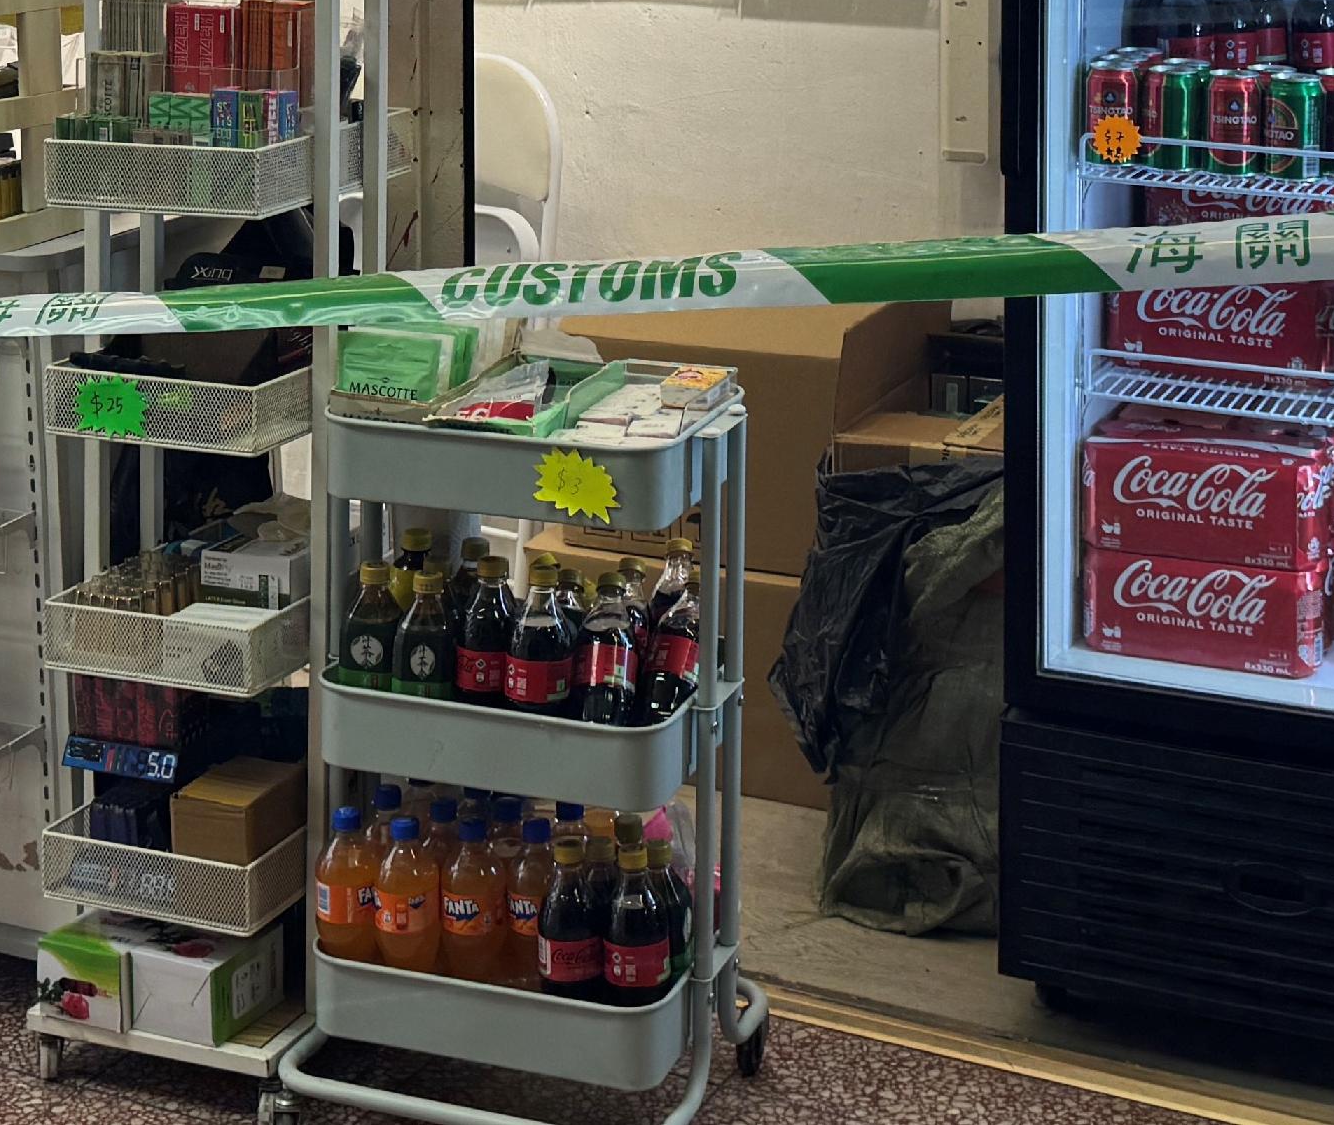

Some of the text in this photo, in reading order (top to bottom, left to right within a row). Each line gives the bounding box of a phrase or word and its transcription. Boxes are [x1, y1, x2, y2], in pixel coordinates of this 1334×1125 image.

[1089, 105, 1133, 117] TSINGTAO
[1212, 114, 1258, 125] TSINGTAO
[1126, 218, 1313, 273] 海關
[441, 251, 744, 307] CUSTOMS
[1137, 284, 1297, 339] Coca-Cola
[1158, 326, 1274, 349] ORIGINAL TASTE
[349, 382, 418, 401] MASCOTTE
[90, 392, 124, 417] $25
[557, 467, 582, 495] $3
[1114, 455, 1278, 518] Coca-Cola
[1136, 506, 1254, 529] ORIGINAL TASTE
[1114, 559, 1277, 624] Coca-Cola
[1136, 611, 1254, 636] ORIGINAL TASTE
[148, 751, 176, 779] 5.0
[444, 898, 480, 916] FANTA
